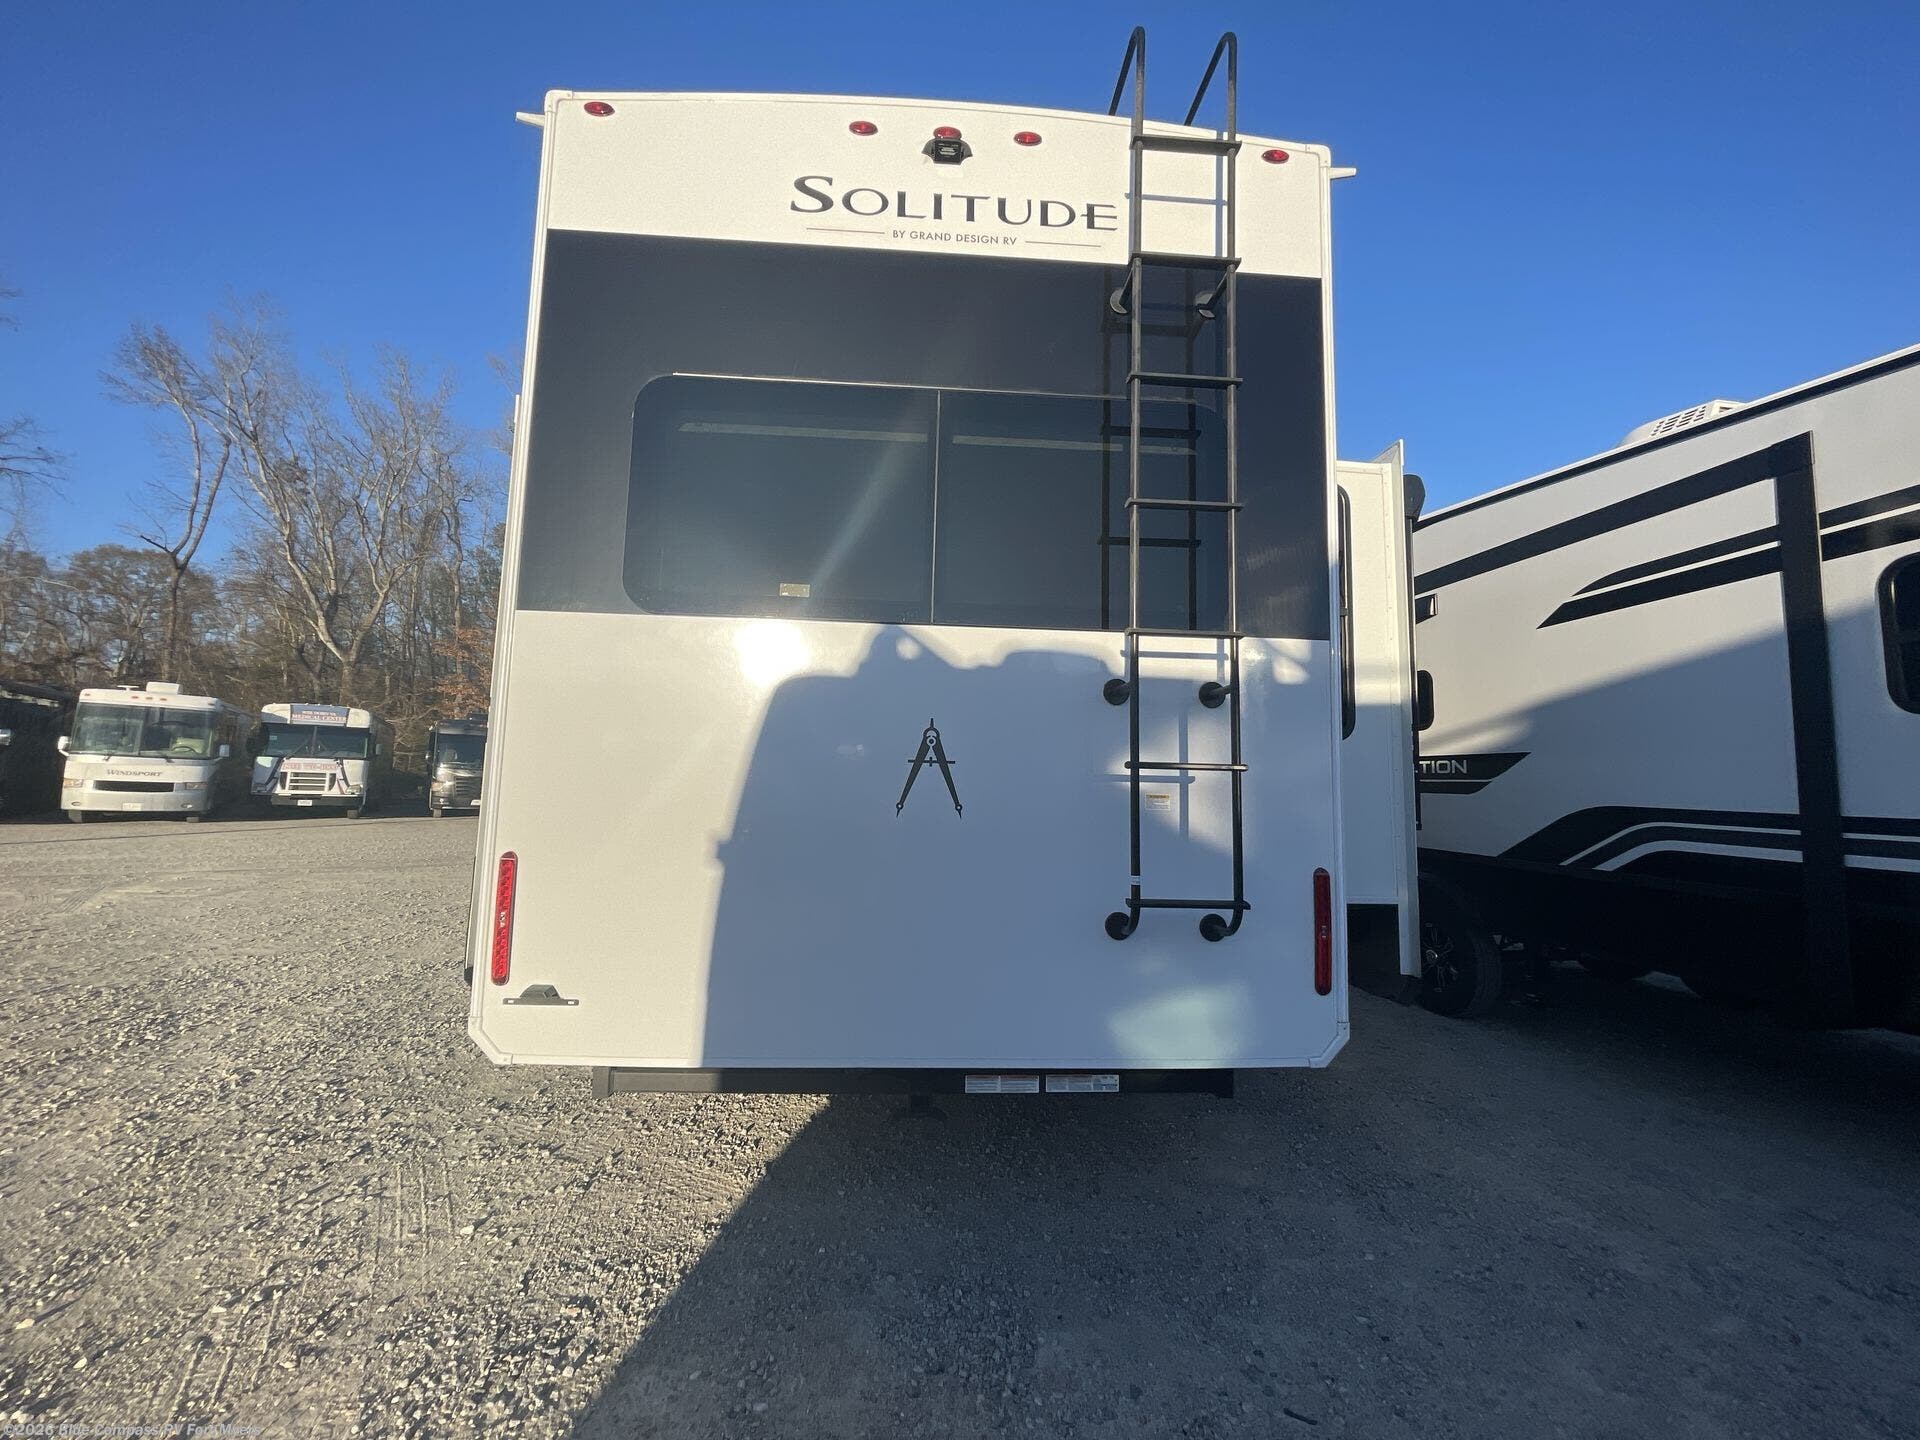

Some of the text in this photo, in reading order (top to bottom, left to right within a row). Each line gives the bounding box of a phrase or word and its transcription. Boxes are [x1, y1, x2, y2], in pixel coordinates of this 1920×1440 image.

[790, 175, 1117, 231] SOLITUDE
[892, 229, 1017, 246] BY GRAND DESIGN RV
[107, 769, 163, 777] WINDSPORT
[1415, 760, 1467, 774] TION
